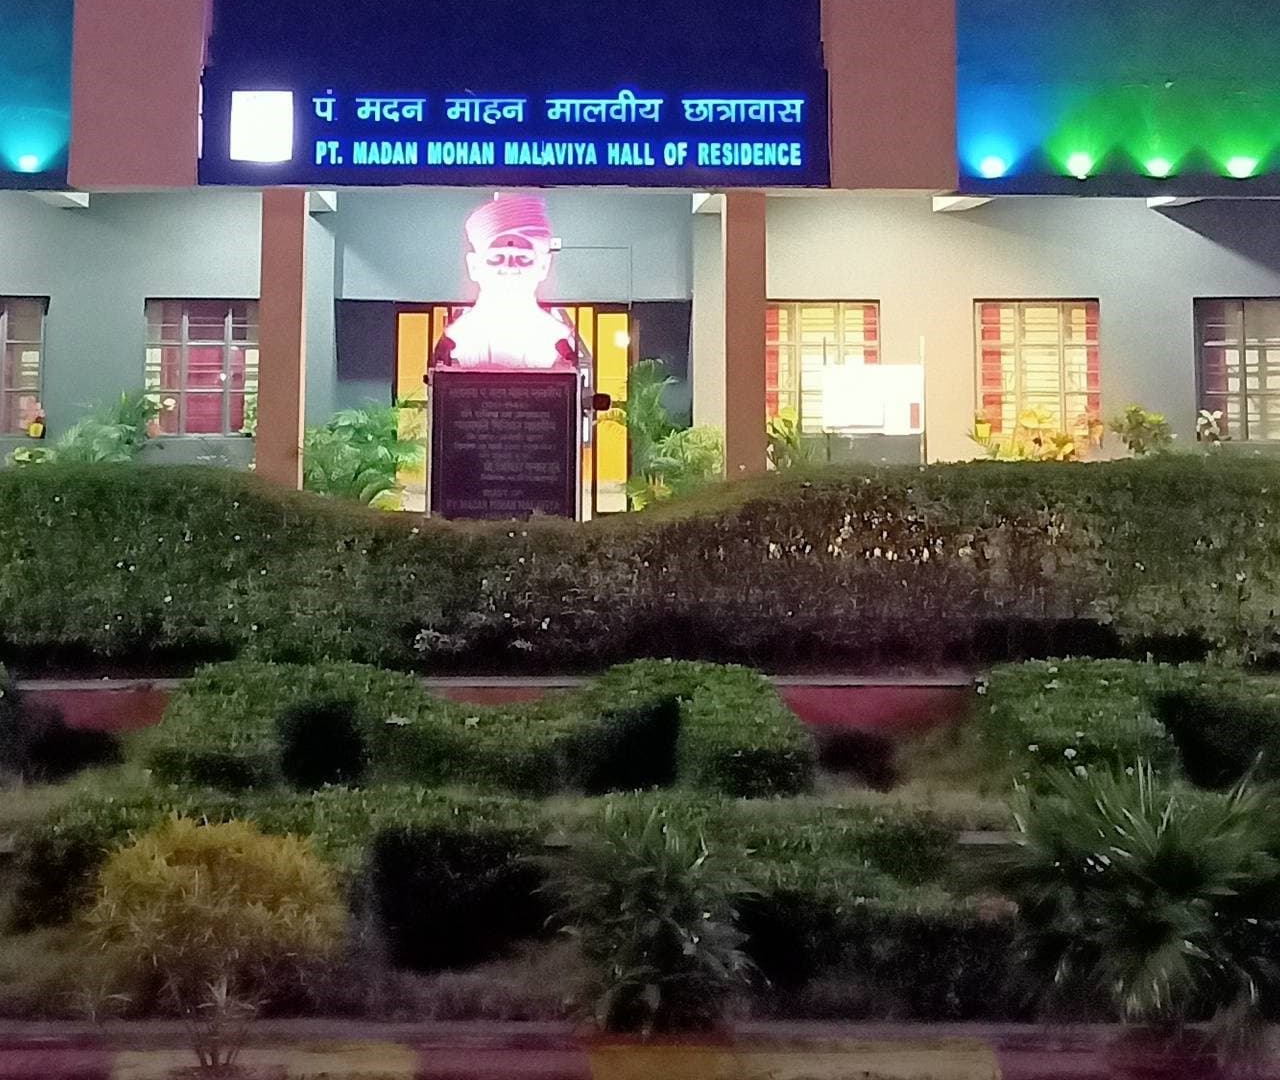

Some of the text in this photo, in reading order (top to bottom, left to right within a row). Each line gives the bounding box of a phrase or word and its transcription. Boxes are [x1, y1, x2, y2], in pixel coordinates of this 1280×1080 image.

[355, 97, 427, 122] मदन
[445, 87, 528, 125] मोहन
[545, 88, 665, 123] मालवीय
[681, 98, 806, 123] छात्रावास
[315, 140, 803, 167] PT. MADAN MOHAN MALAVIYA HALL OF RESIDENCE
